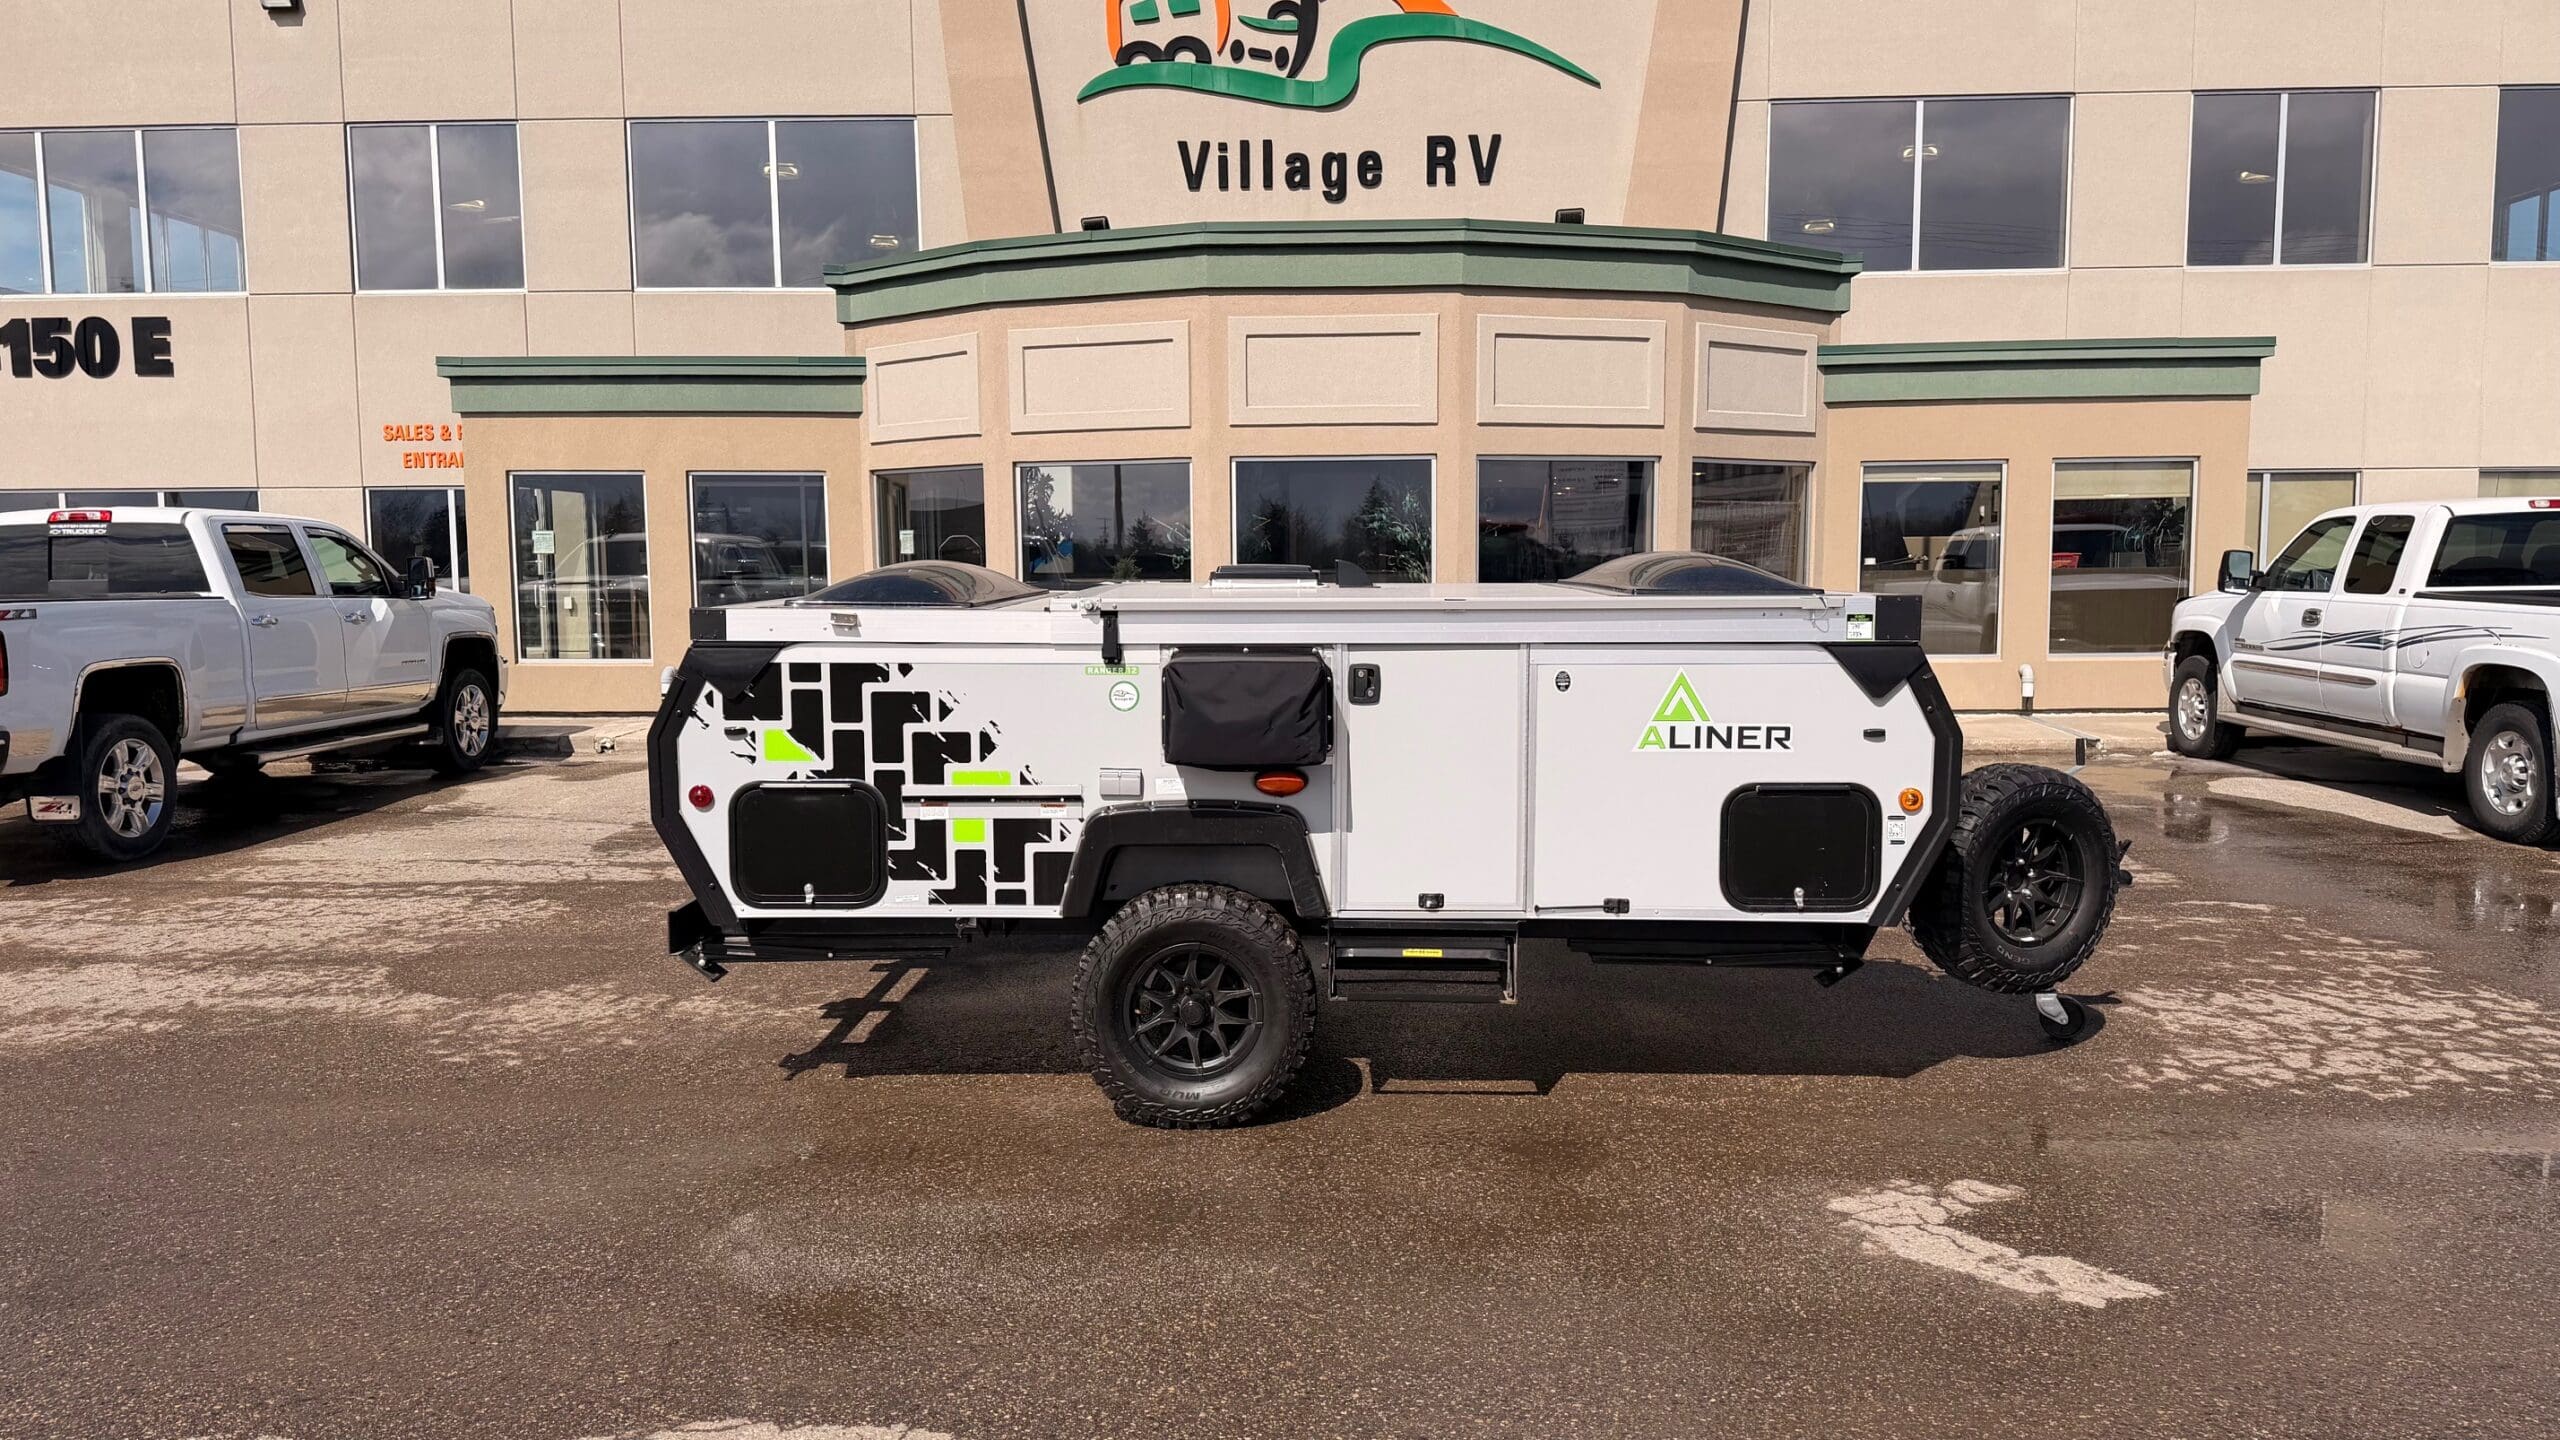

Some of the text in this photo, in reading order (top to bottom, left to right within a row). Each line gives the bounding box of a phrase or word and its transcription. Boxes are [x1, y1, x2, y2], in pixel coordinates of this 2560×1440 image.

[1177, 133, 1501, 205] Village RV
[0, 316, 175, 379] 150 E
[383, 424, 435, 441] SALES
[440, 424, 452, 441] &
[1638, 725, 1792, 750] ALINER
